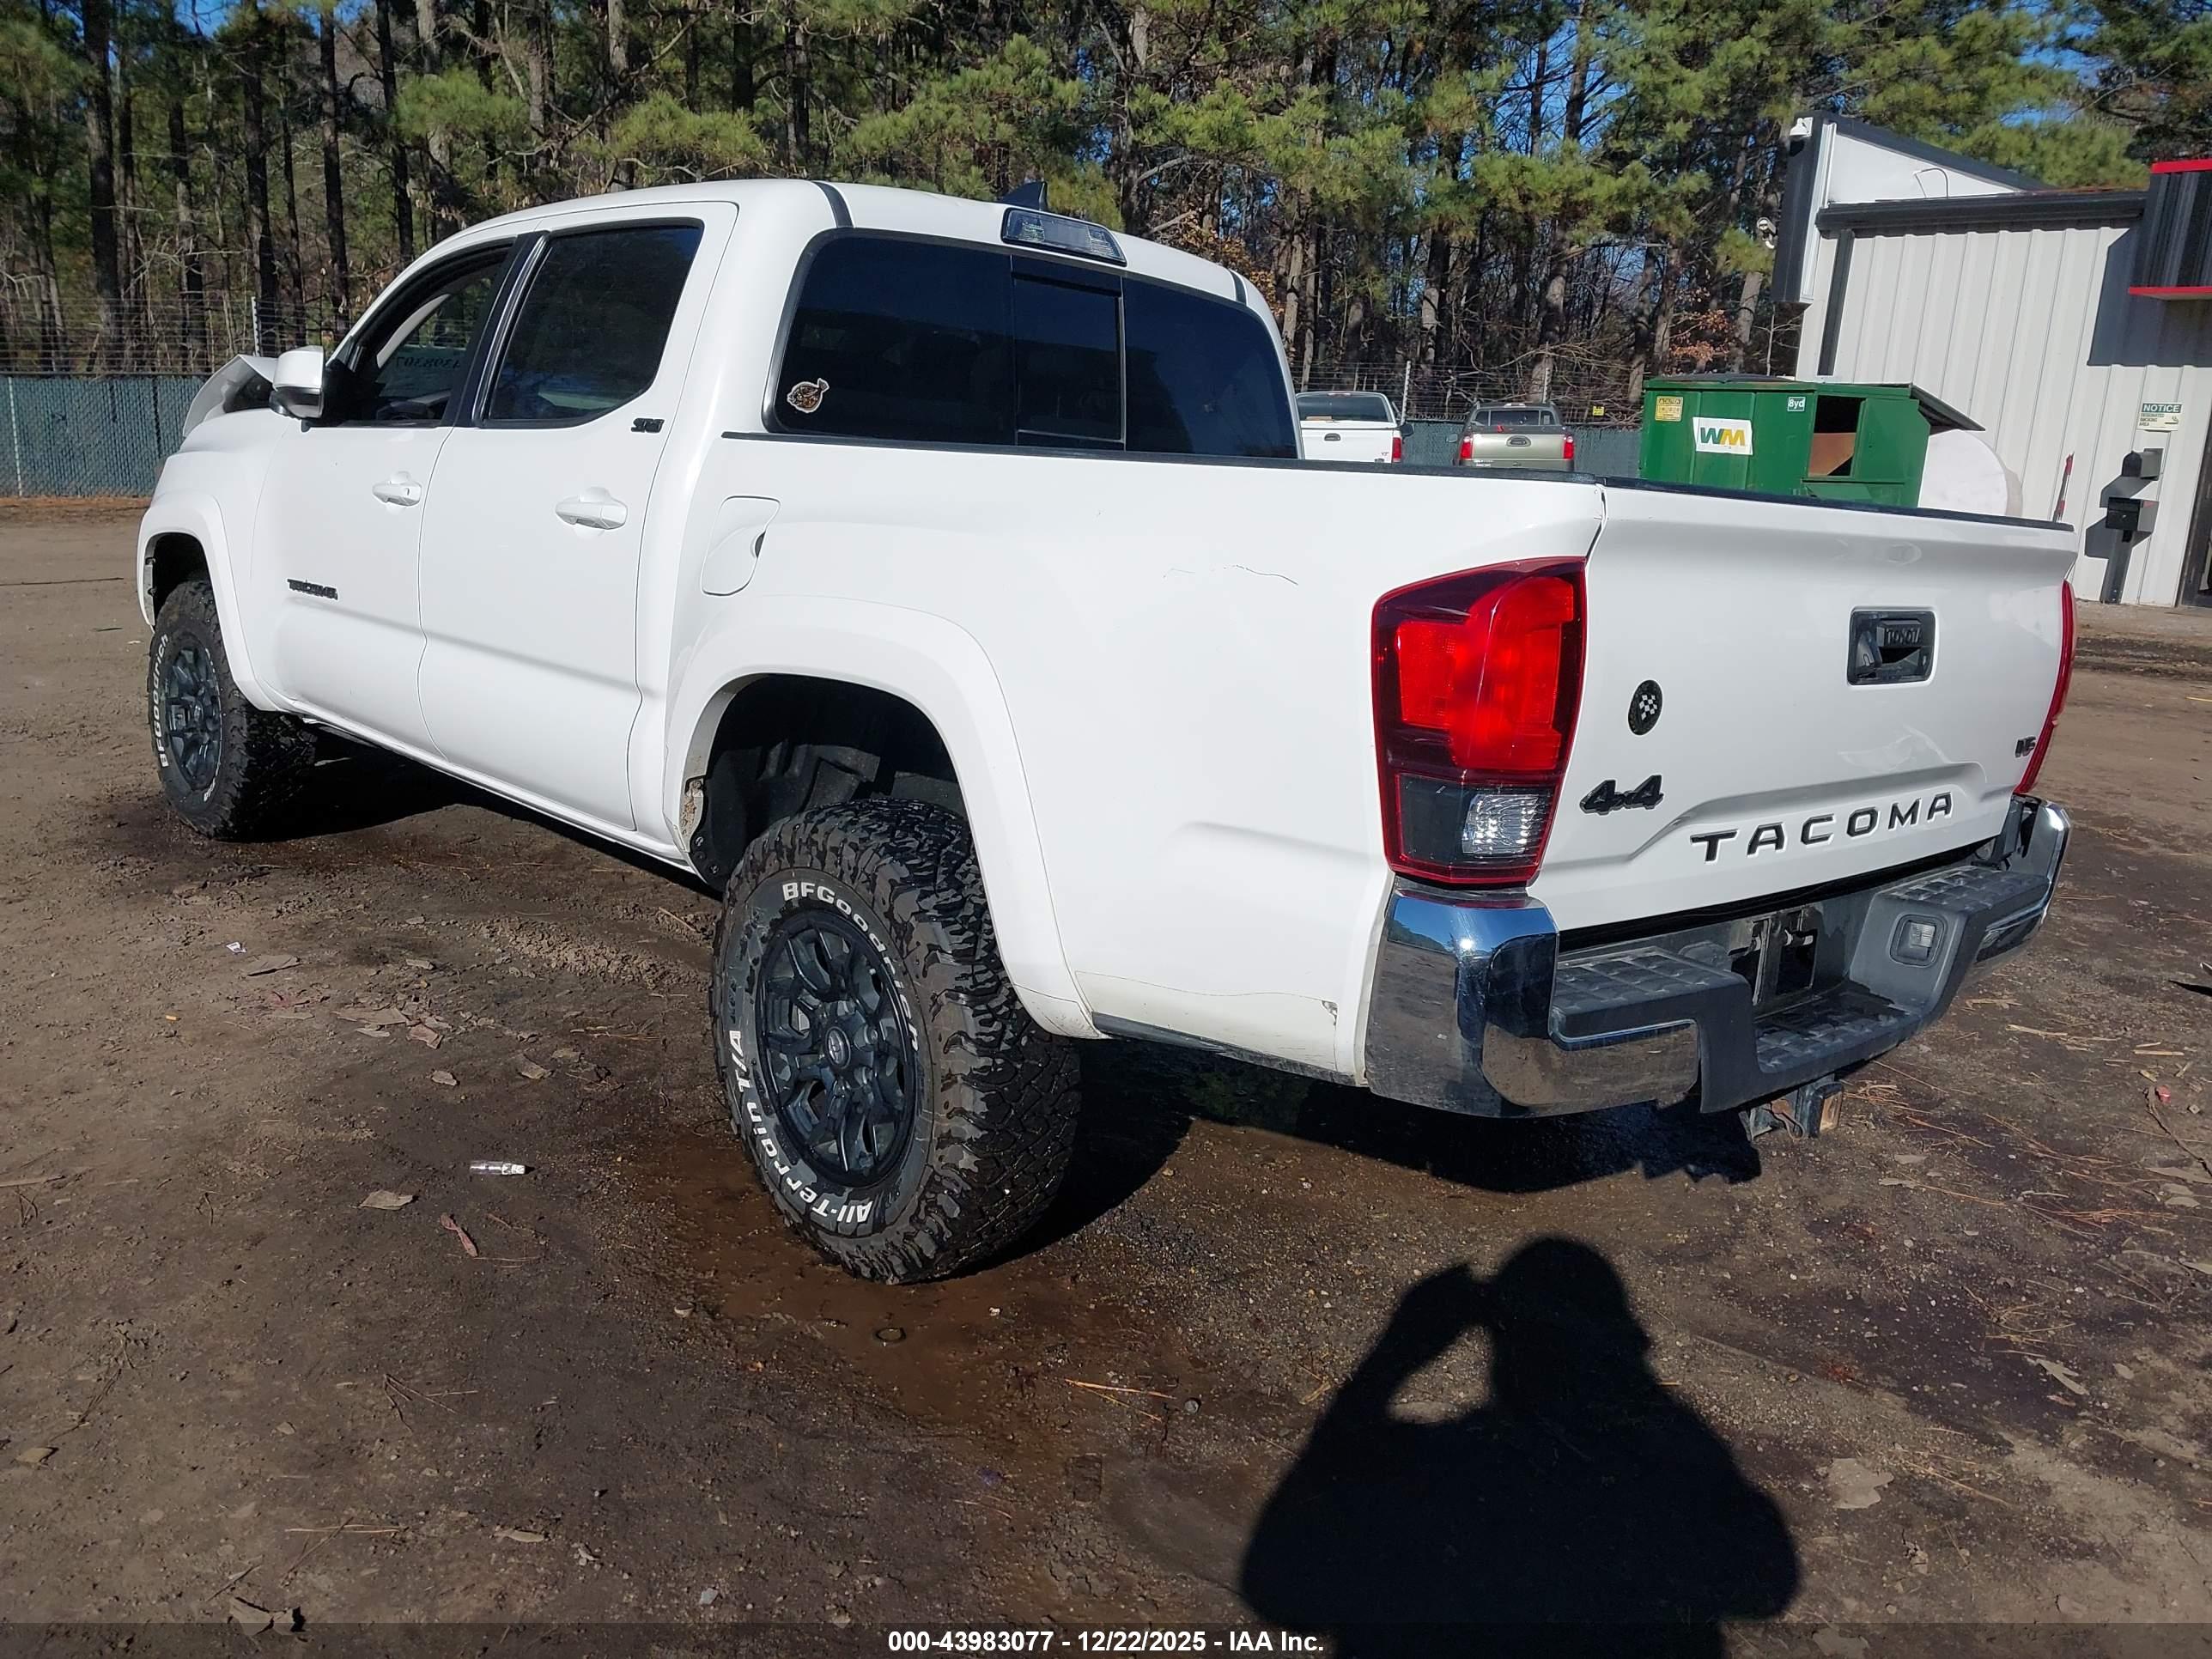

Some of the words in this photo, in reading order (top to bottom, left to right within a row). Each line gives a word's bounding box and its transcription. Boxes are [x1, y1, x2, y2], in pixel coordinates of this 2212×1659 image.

[1789, 398, 1805, 410] 8yd
[2143, 404, 2180, 412] NOTICE
[1700, 427, 1746, 447] WM
[1690, 792, 1954, 863] TACOMA
[730, 1030, 750, 1092] T/A
